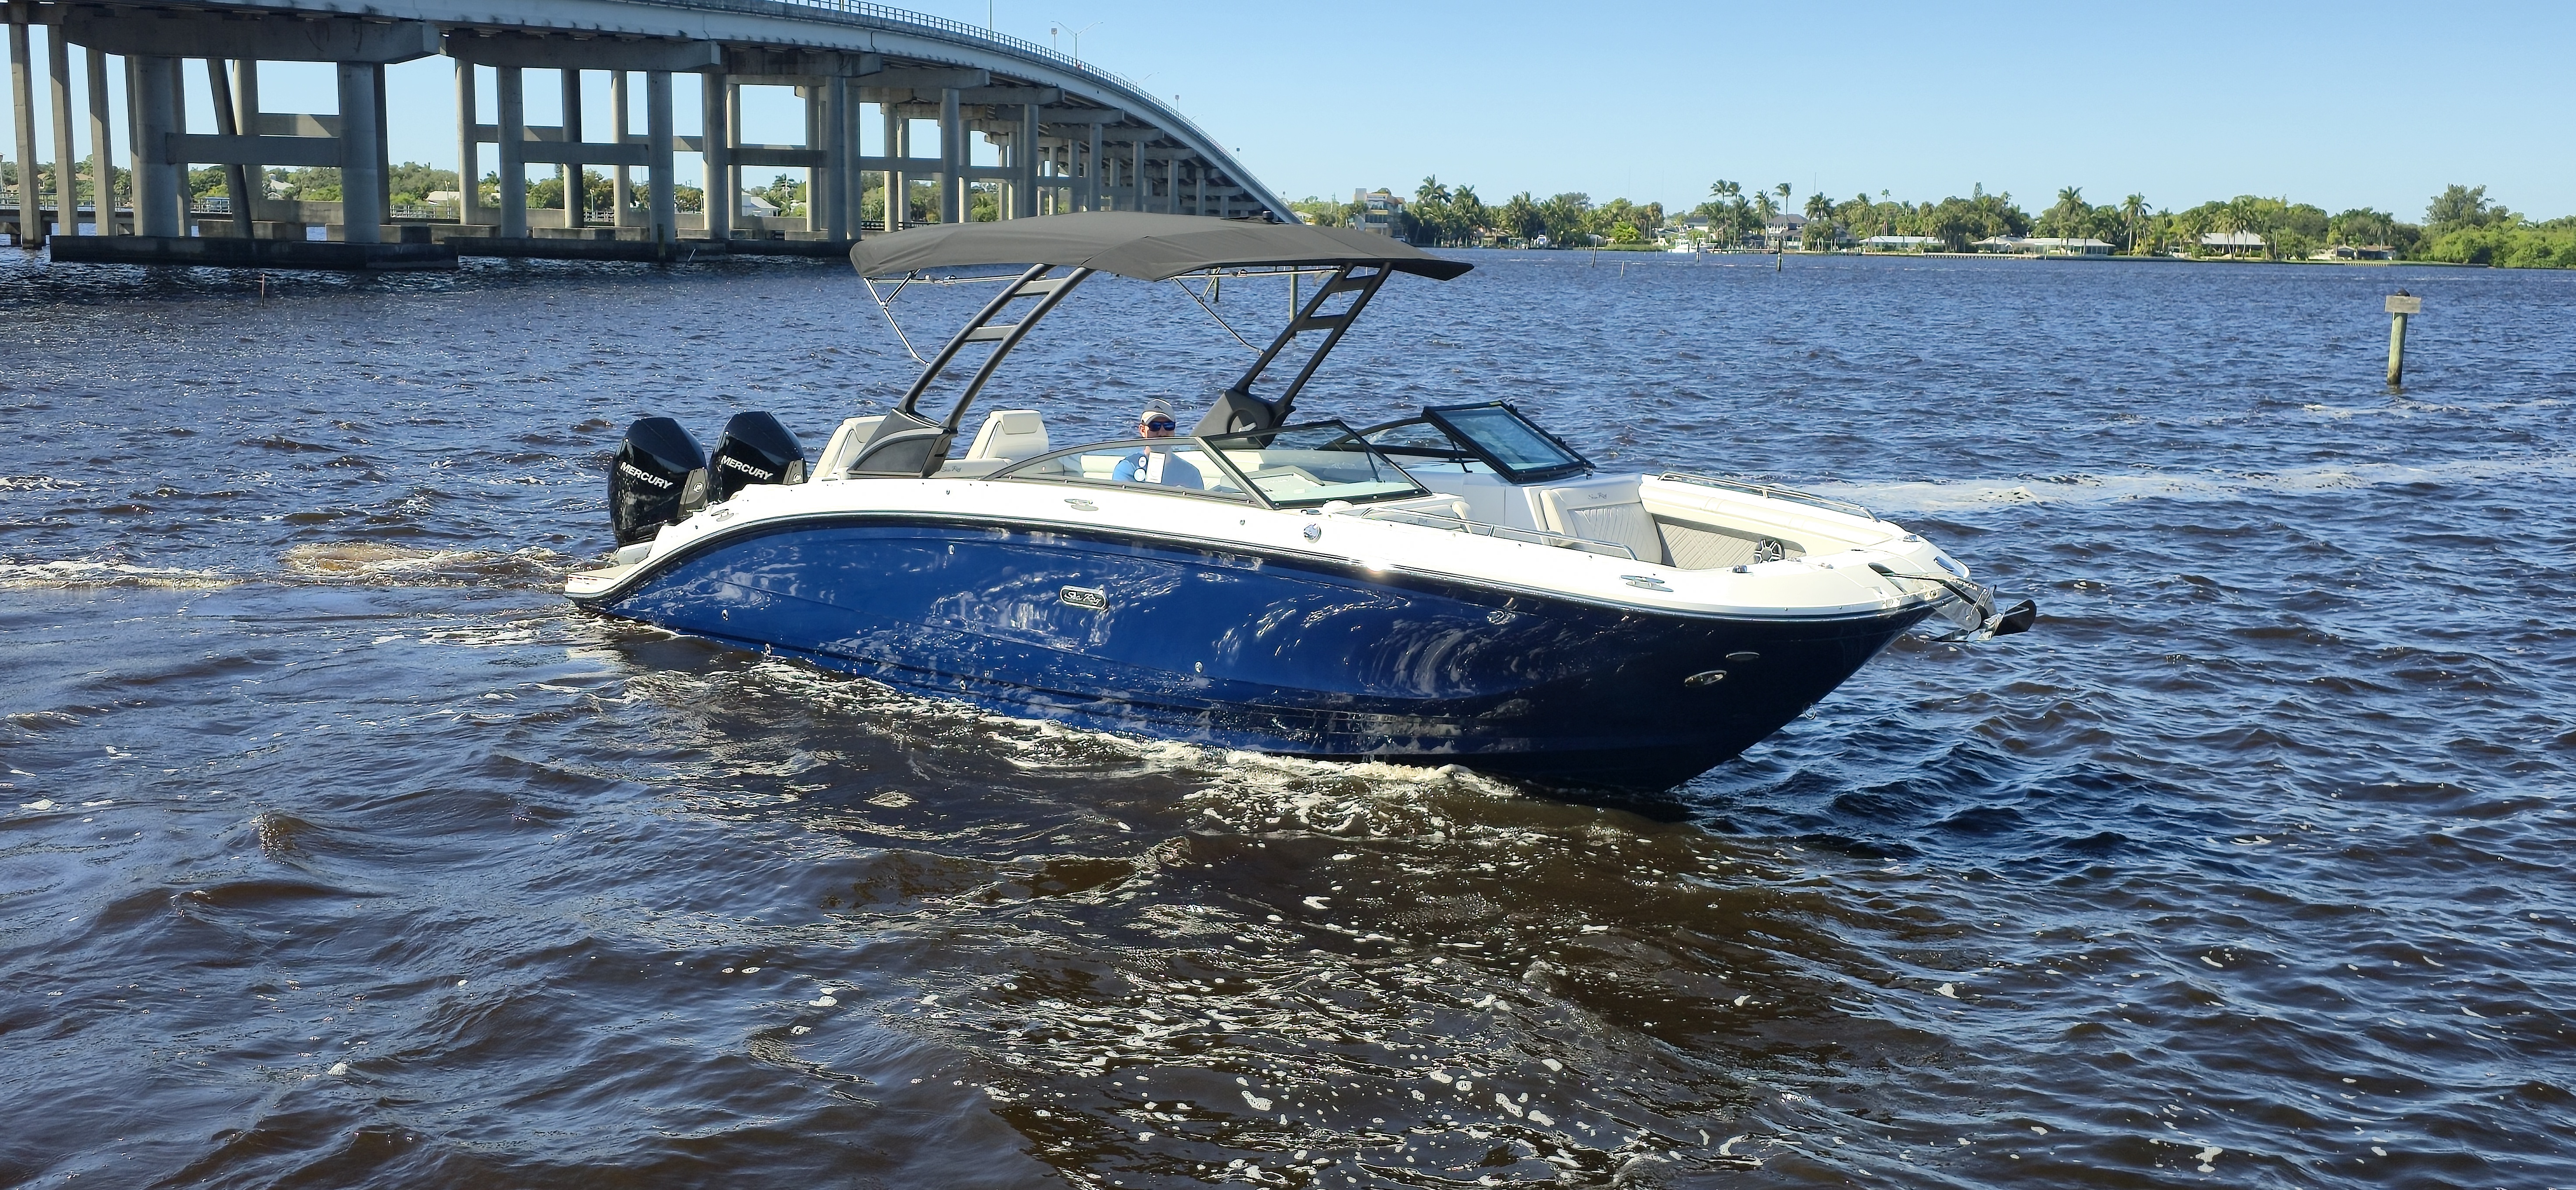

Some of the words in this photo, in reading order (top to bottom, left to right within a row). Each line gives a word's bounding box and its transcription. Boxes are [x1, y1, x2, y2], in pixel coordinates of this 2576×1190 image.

[620, 462, 674, 489] MERCURY
[720, 455, 774, 480] MERCURY
[1063, 591, 1083, 601] Sea
[1082, 593, 1102, 605] Ray
